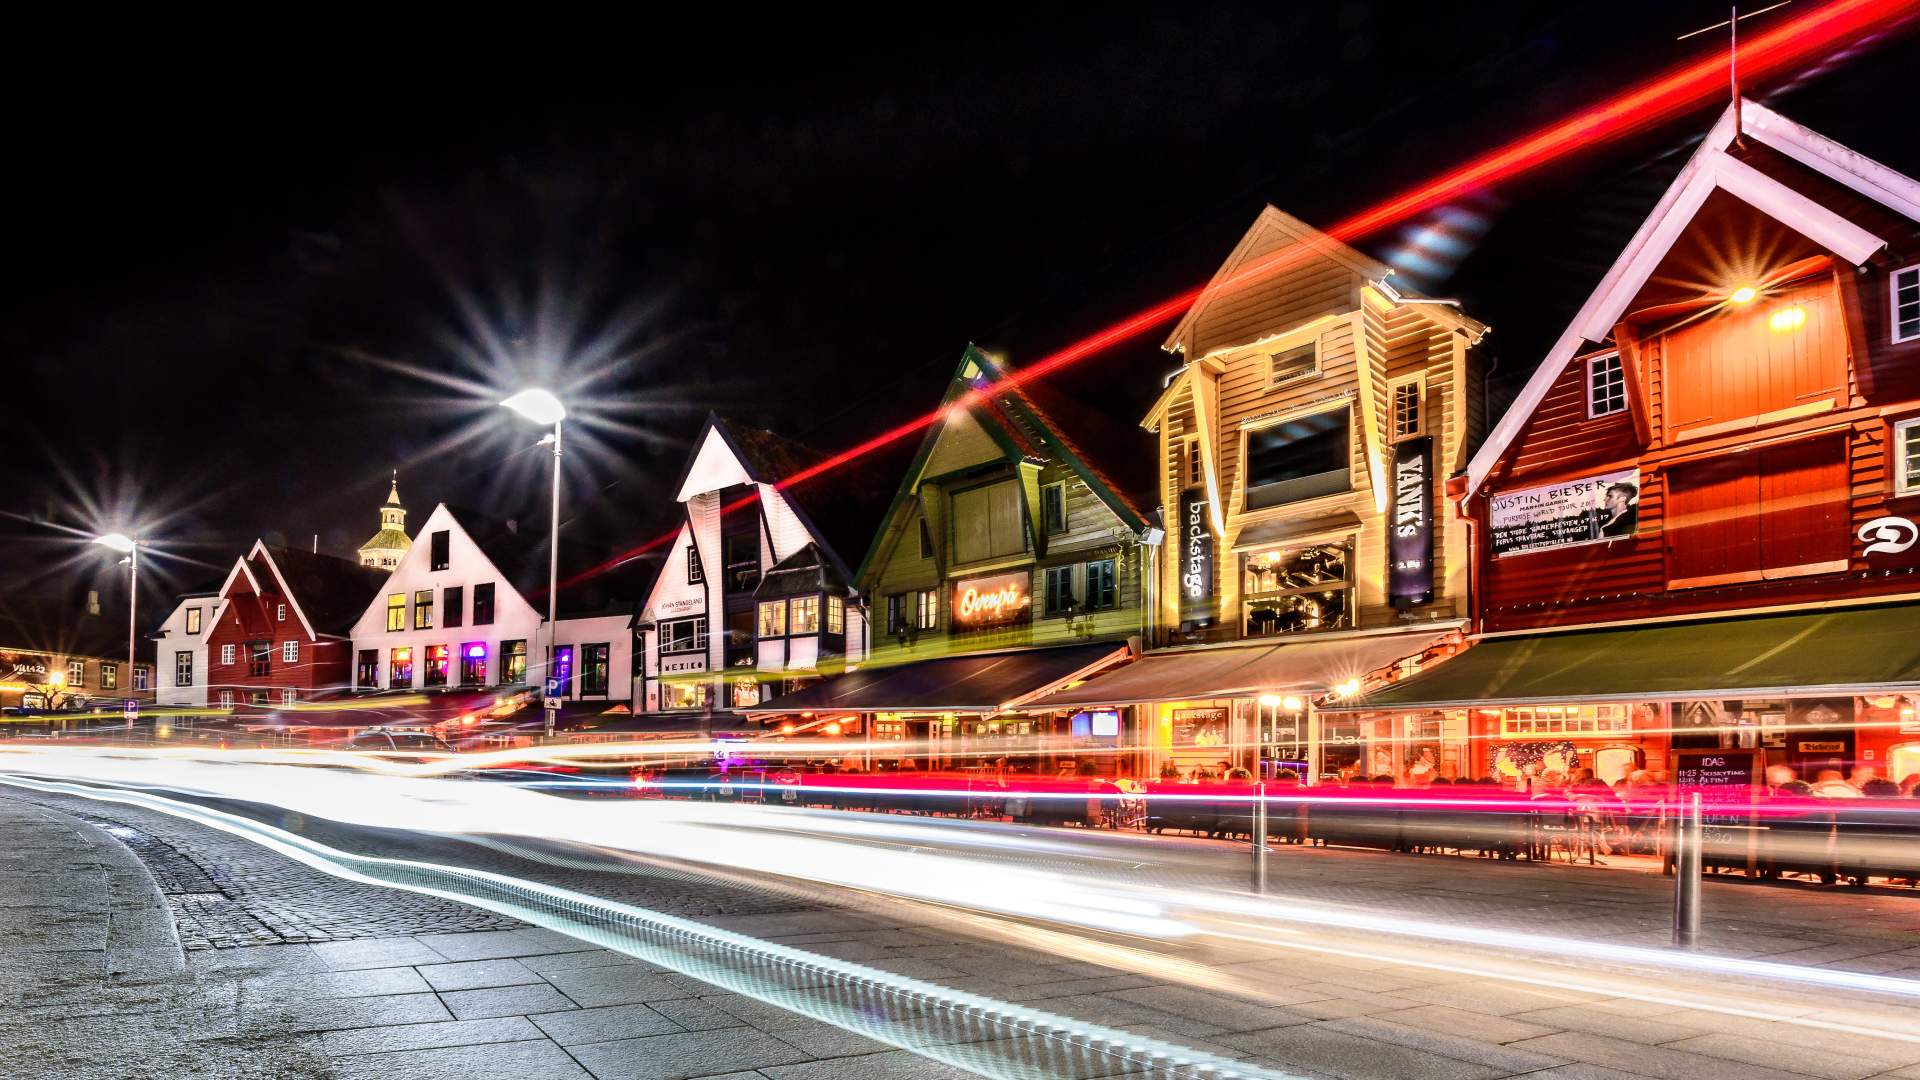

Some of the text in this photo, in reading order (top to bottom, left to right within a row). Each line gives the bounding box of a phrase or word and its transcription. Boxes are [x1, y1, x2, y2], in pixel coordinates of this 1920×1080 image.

[1493, 480, 1606, 512] JUSTIN BIEBER
[1503, 512, 1531, 524] PURPOSE
[1533, 507, 1555, 518] WORLD
[1558, 503, 1577, 511] TOUR
[1184, 500, 1210, 597] backstage
[549, 680, 558, 695] P
[128, 702, 136, 711] P
[1702, 757, 1726, 767] IDAG
